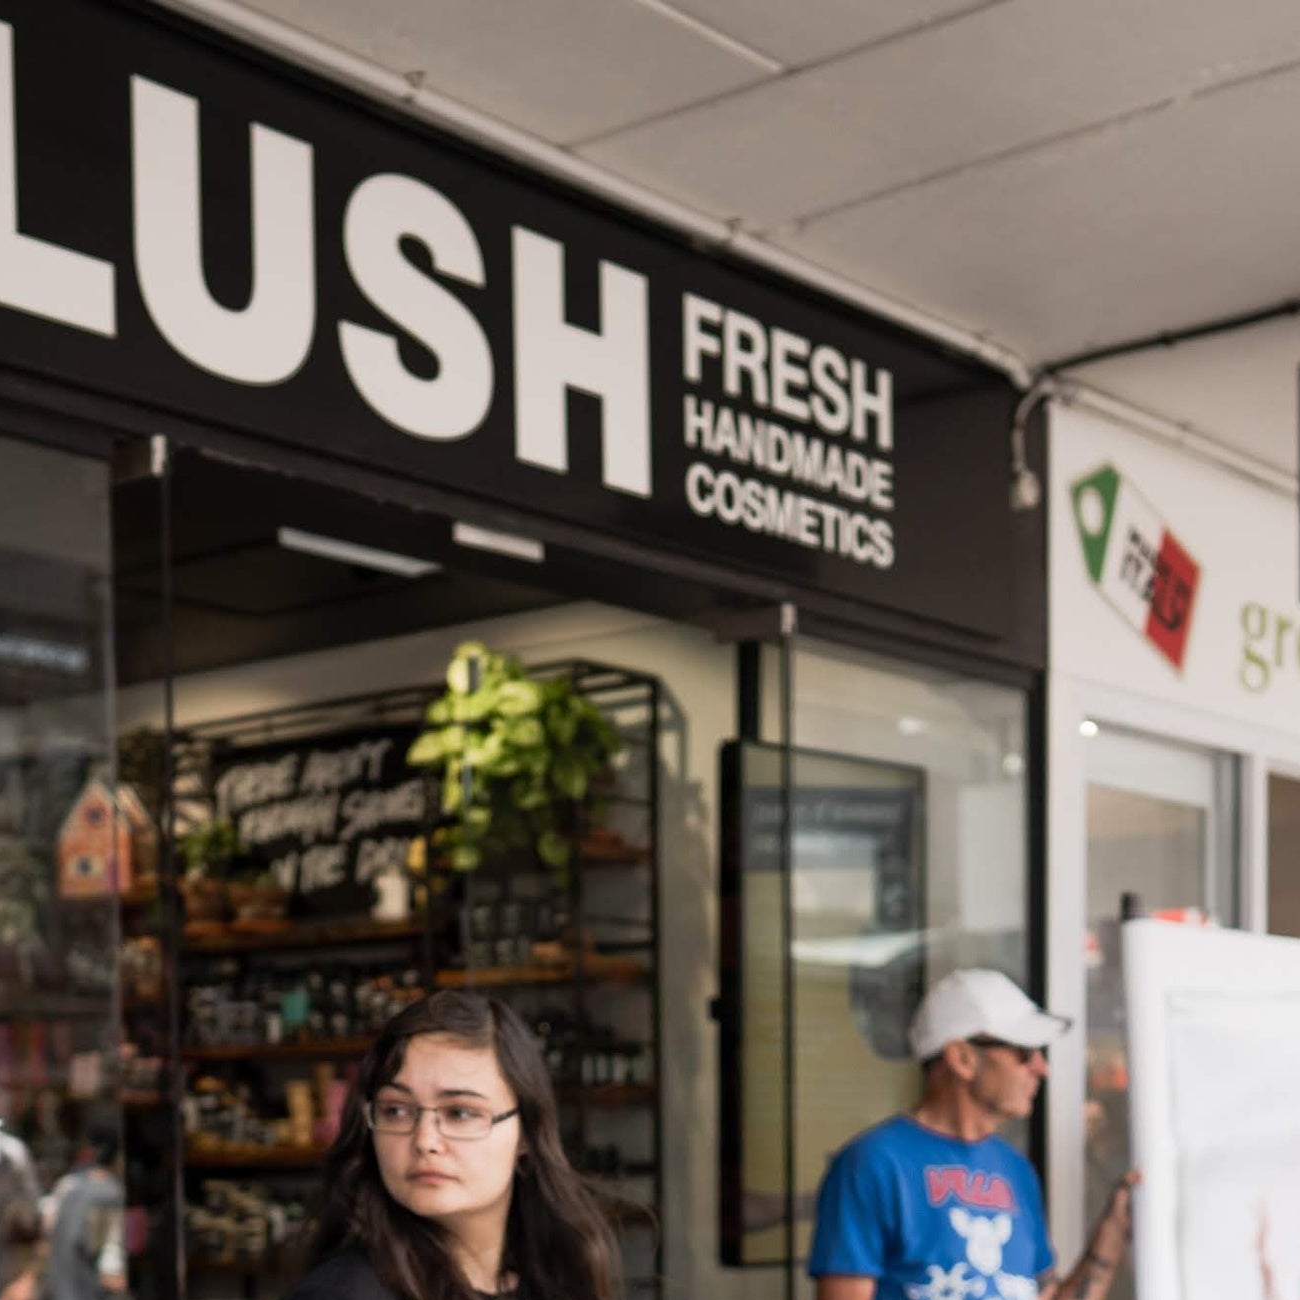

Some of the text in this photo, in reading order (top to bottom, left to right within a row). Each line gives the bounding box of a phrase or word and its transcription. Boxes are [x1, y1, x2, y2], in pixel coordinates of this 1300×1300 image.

[683, 292, 893, 449] FRESH
[684, 396, 893, 510] HANDMADE
[687, 465, 894, 567] COSMETICS
